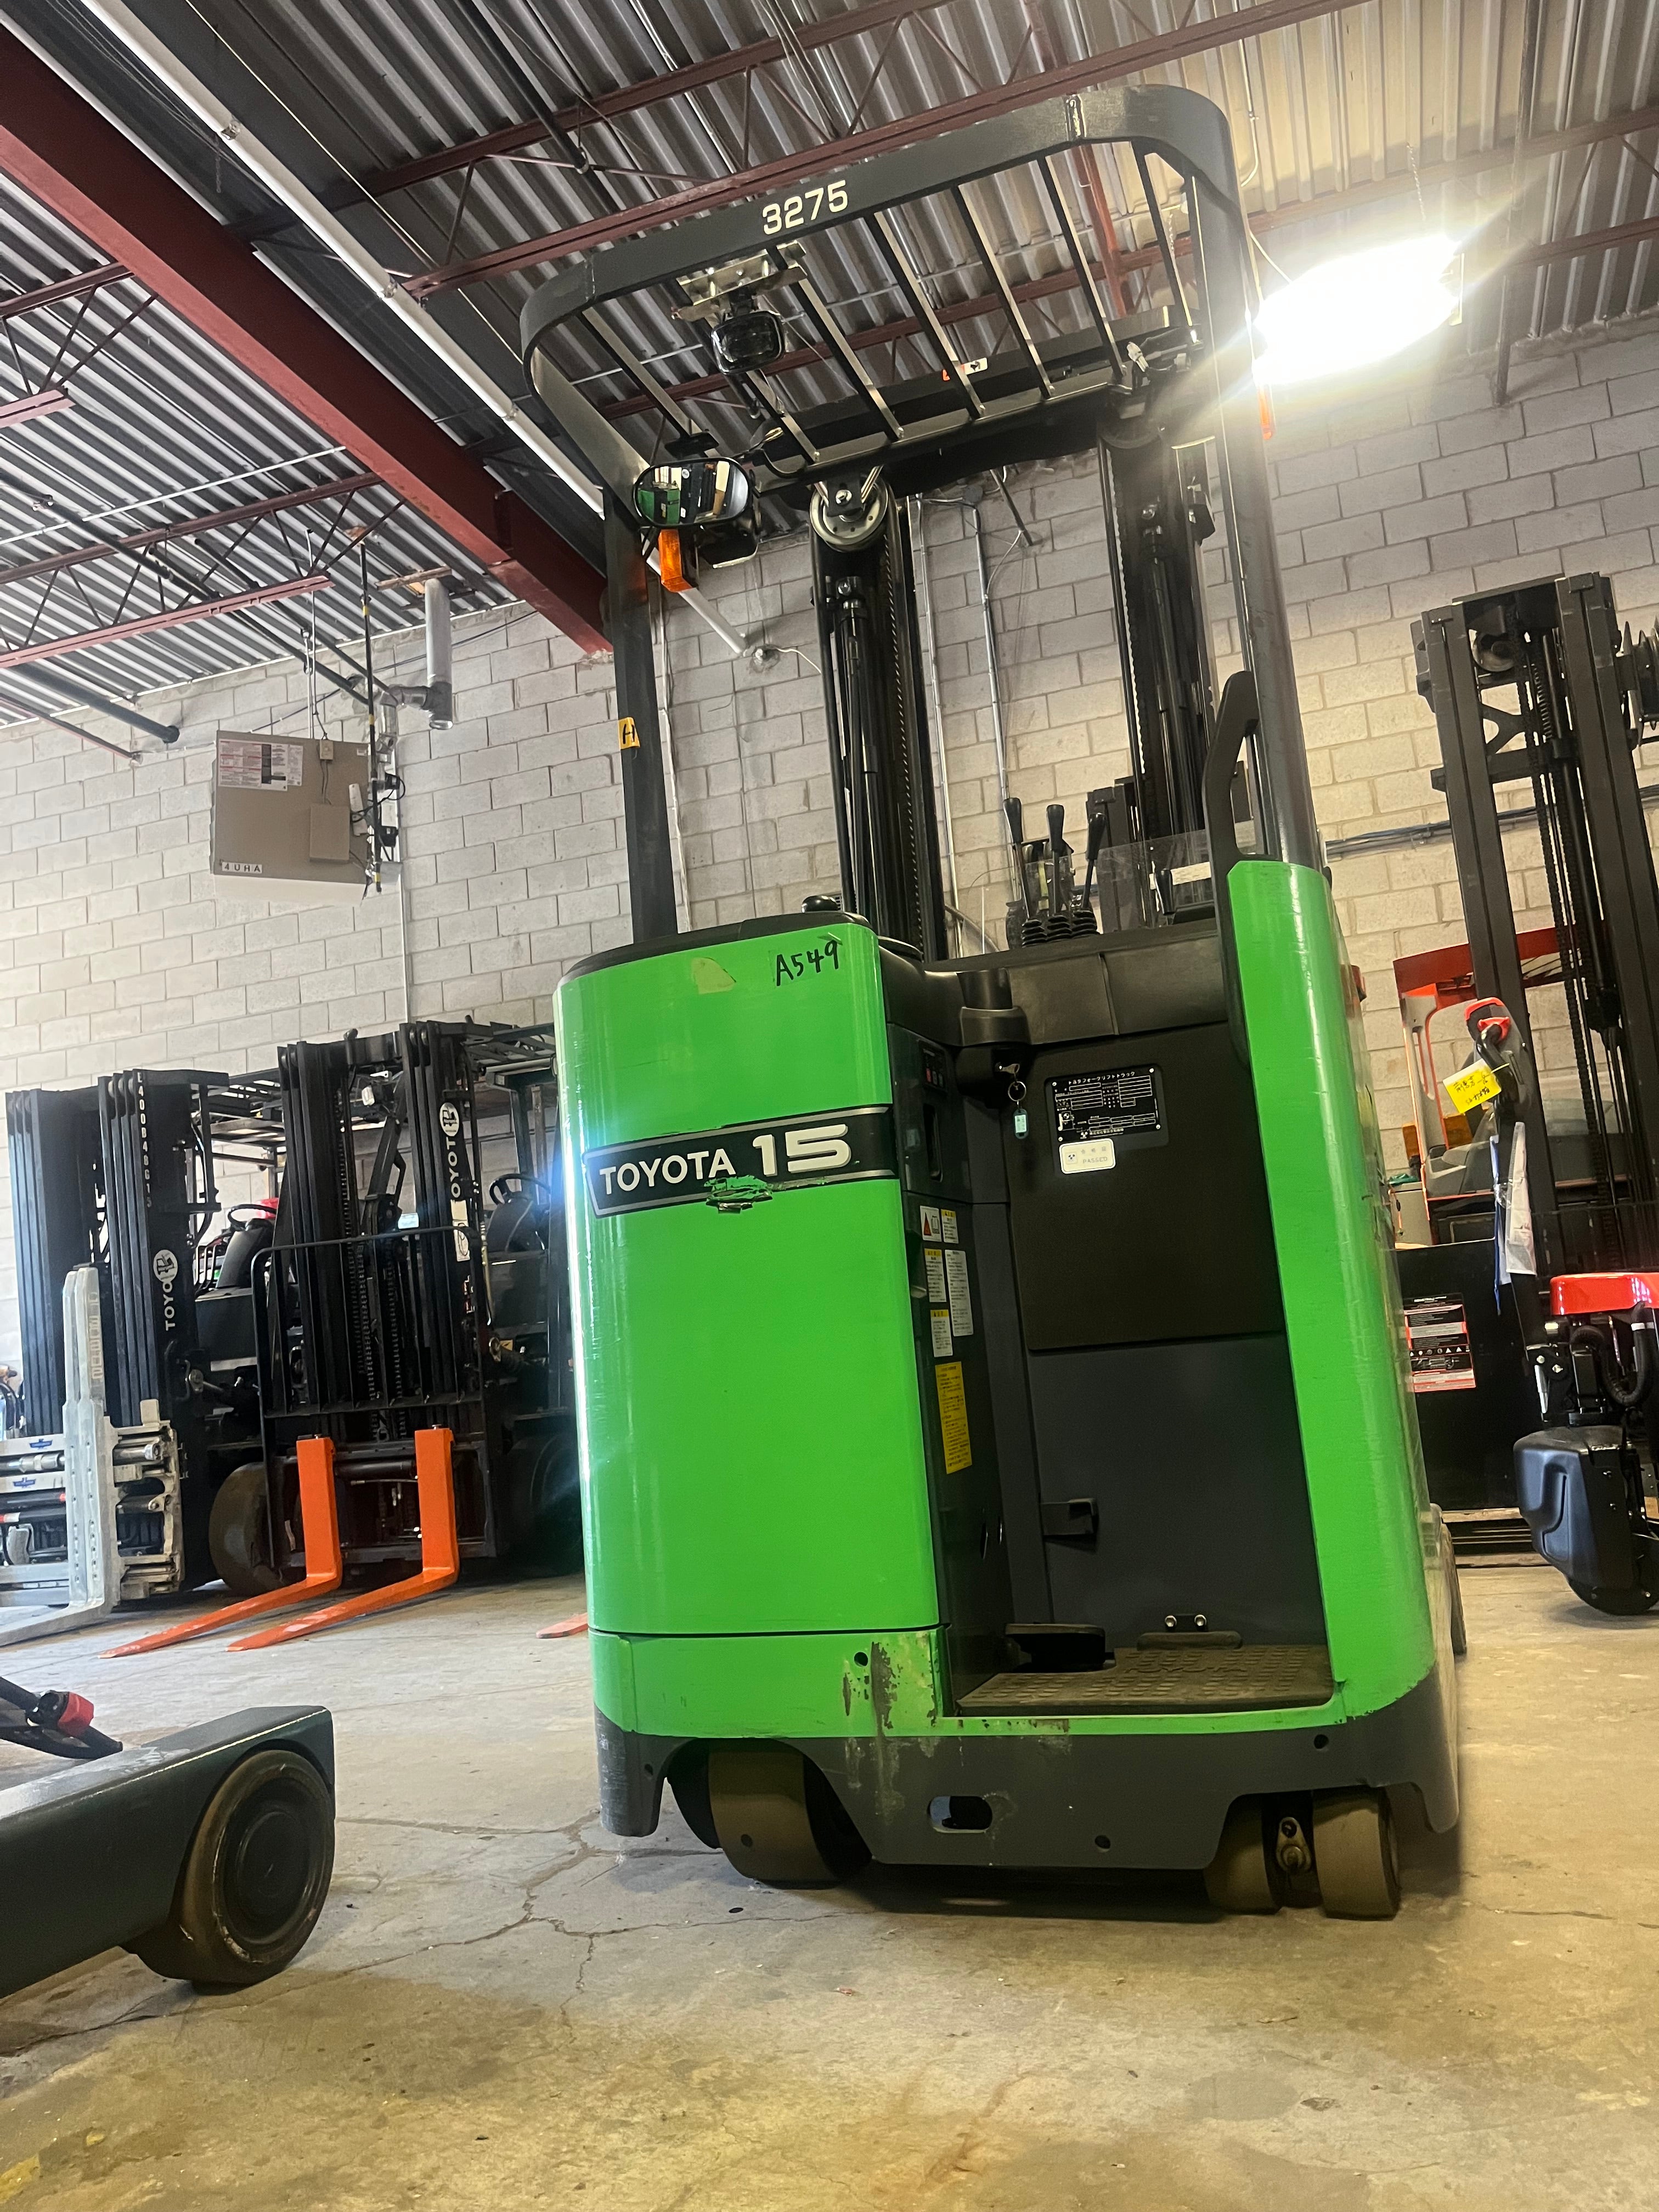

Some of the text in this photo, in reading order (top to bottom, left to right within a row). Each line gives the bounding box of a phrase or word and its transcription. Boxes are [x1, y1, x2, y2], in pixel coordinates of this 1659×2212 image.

[763, 180, 848, 235] 3275
[776, 940, 839, 986] A549
[446, 1137, 461, 1198] OYOT
[600, 1124, 851, 1195] TOYOTA 15
[163, 1281, 176, 1331] TOYO
